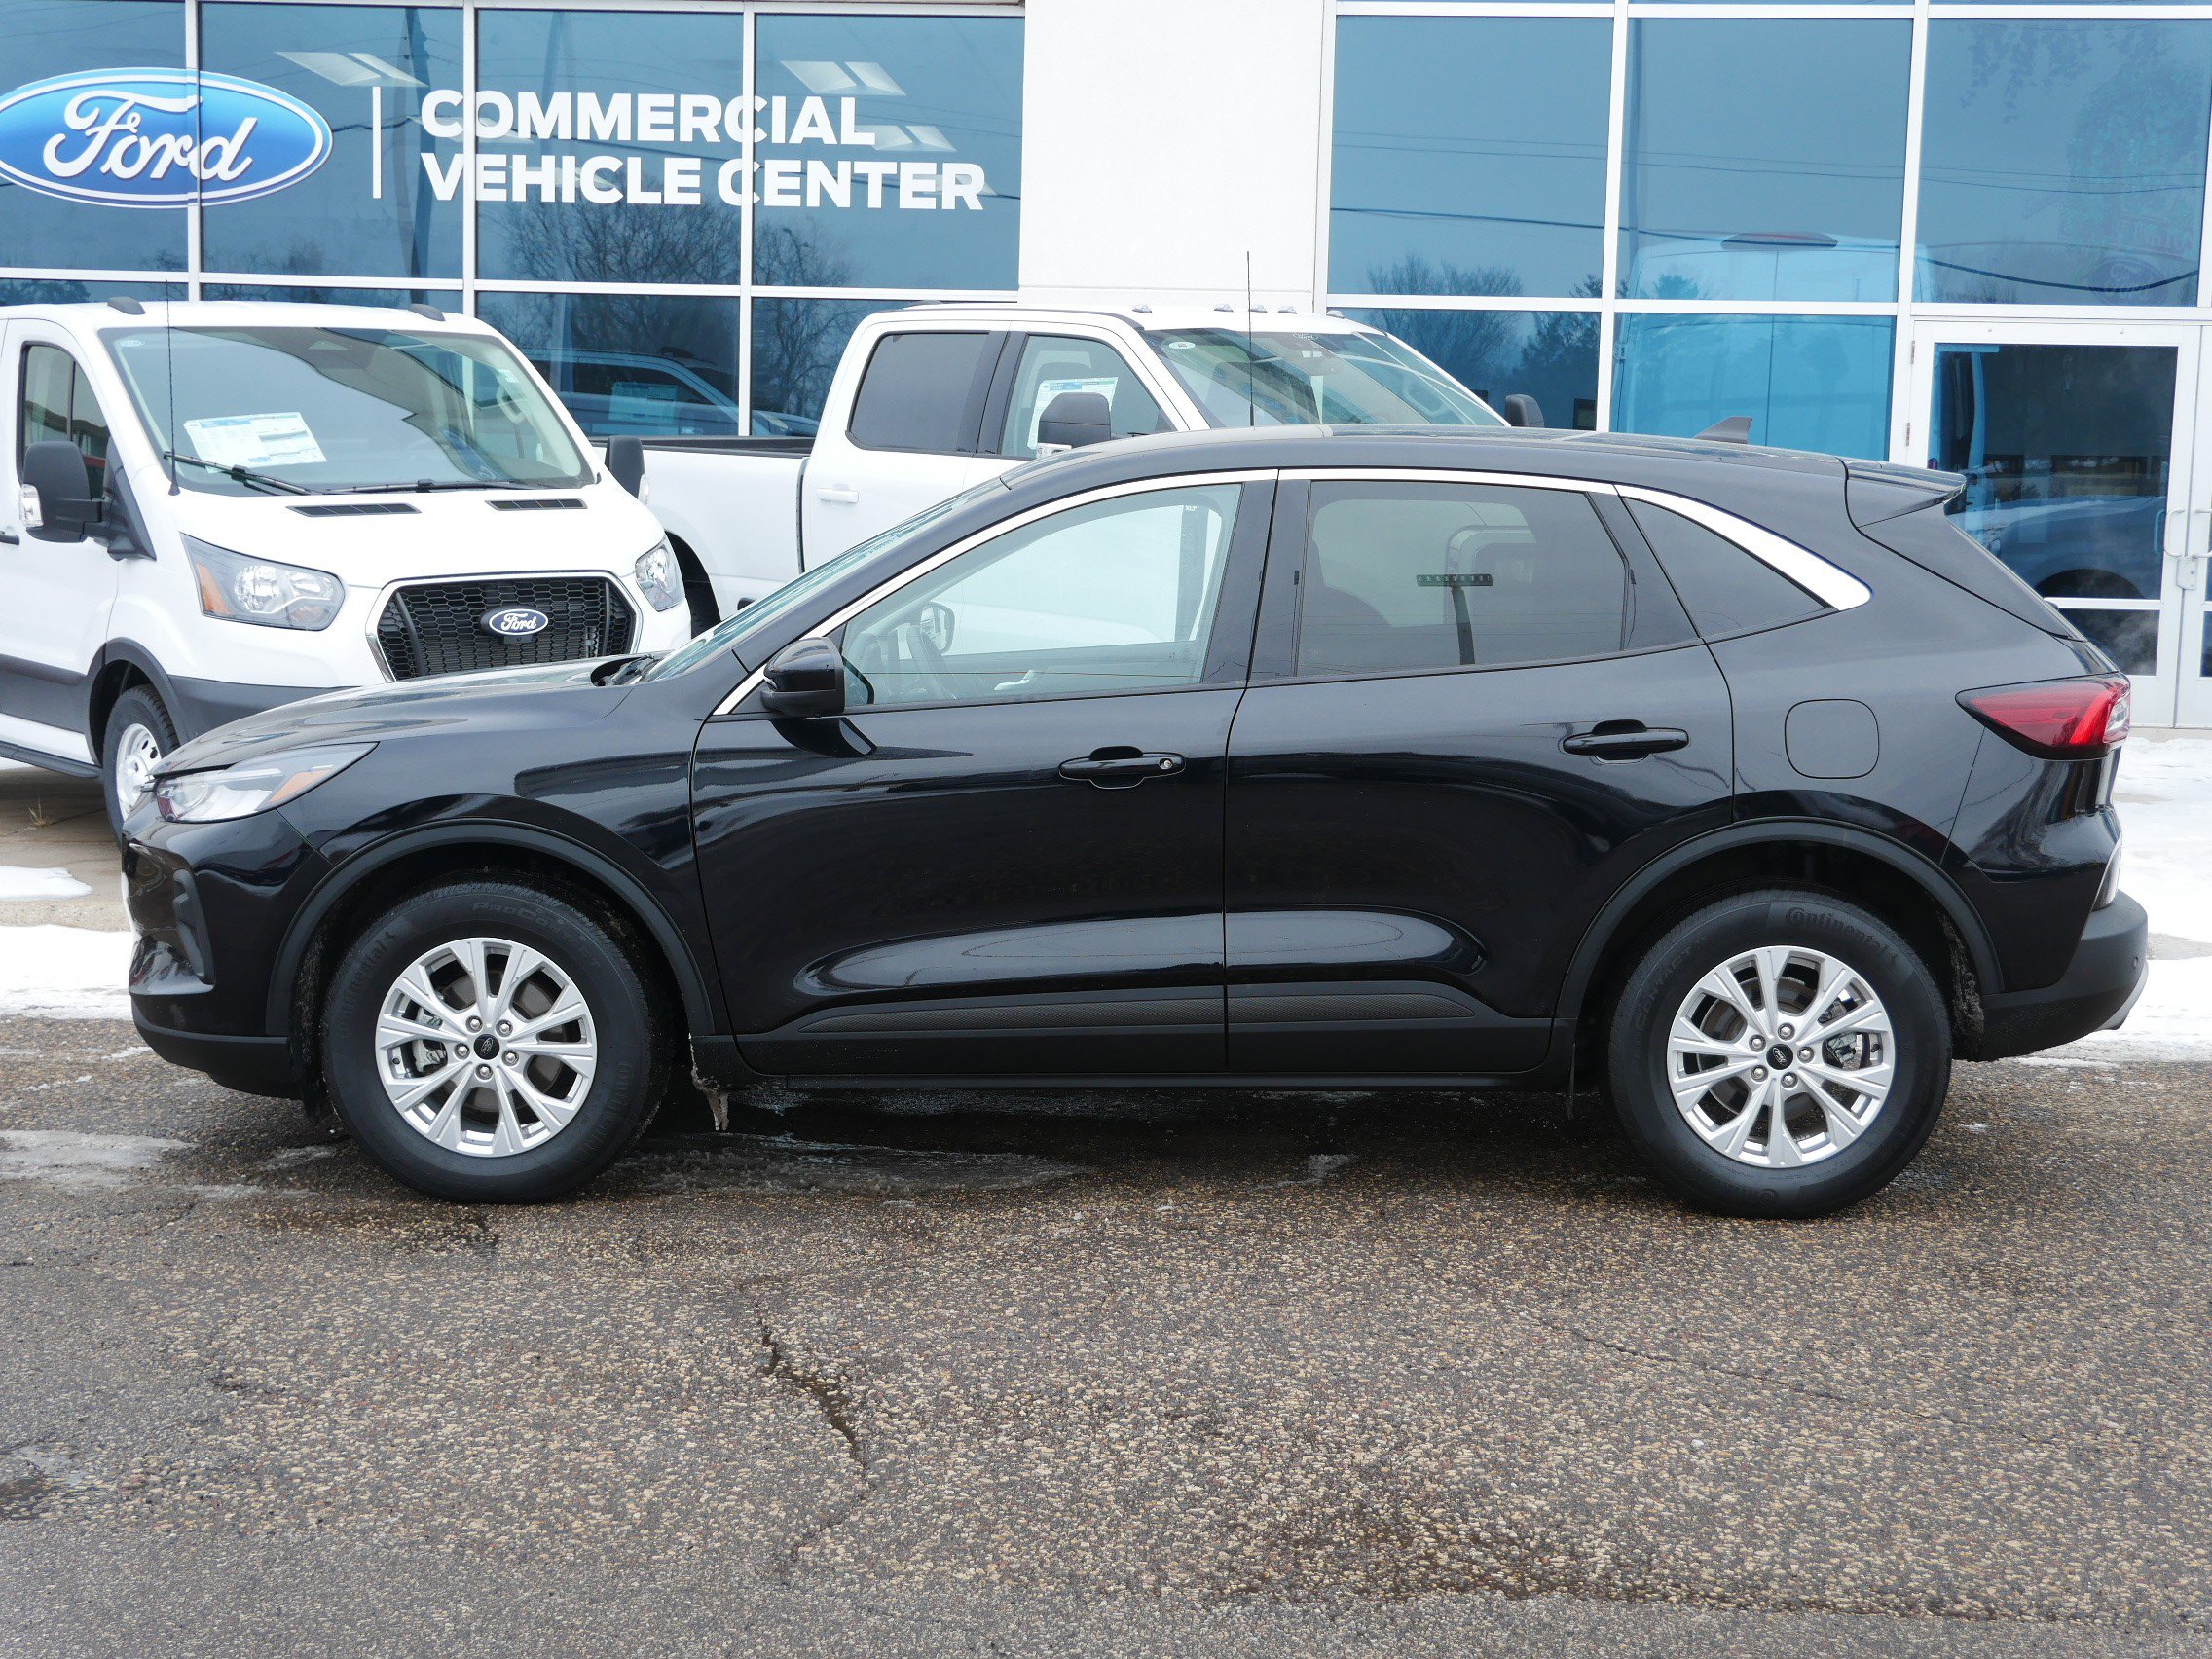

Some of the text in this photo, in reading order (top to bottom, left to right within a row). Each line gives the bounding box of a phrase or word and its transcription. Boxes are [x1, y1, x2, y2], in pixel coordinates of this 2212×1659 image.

[43, 90, 258, 181] Ford
[421, 89, 875, 145] COMMERCIAL
[421, 153, 985, 210] VEHICLE CENTER
[500, 612, 537, 631] Ford
